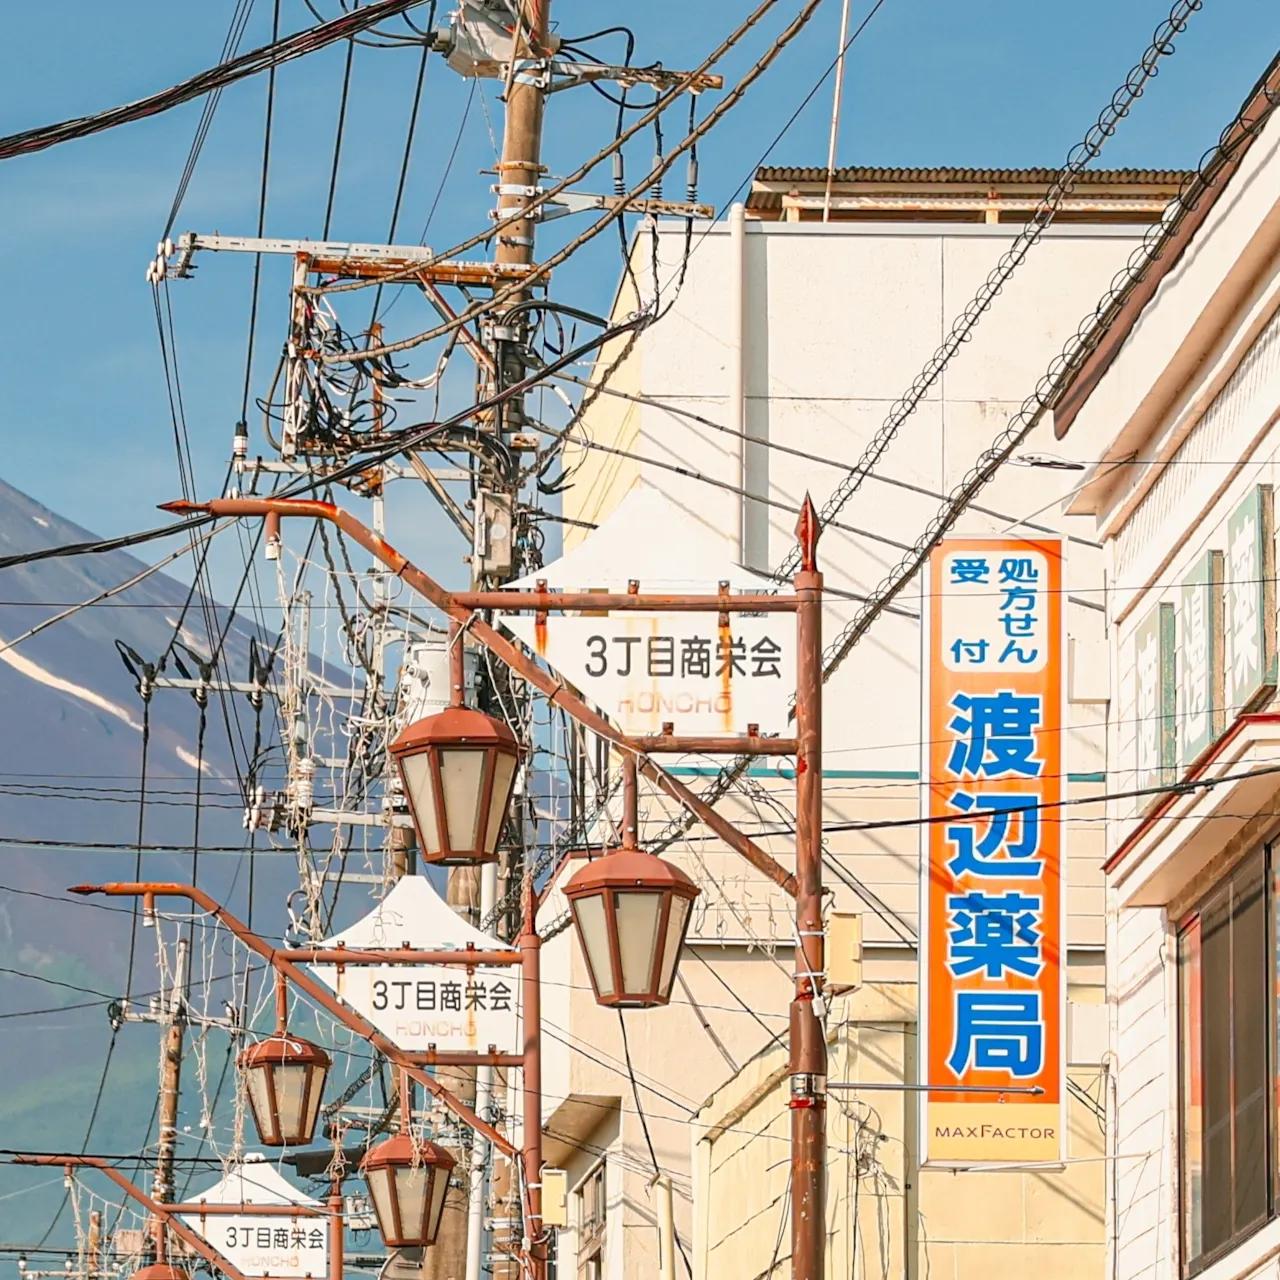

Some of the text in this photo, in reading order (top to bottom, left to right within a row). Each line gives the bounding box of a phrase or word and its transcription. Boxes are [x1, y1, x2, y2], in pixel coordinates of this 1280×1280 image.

[950, 558, 990, 664] 受付
[998, 558, 1038, 664] 処方せん
[584, 635, 782, 678] 3丁目商栄会
[948, 692, 1043, 1076] 渡辺薬局
[372, 980, 512, 1012] 3丁目商栄会
[226, 1226, 324, 1250] 3丁目商栄会
